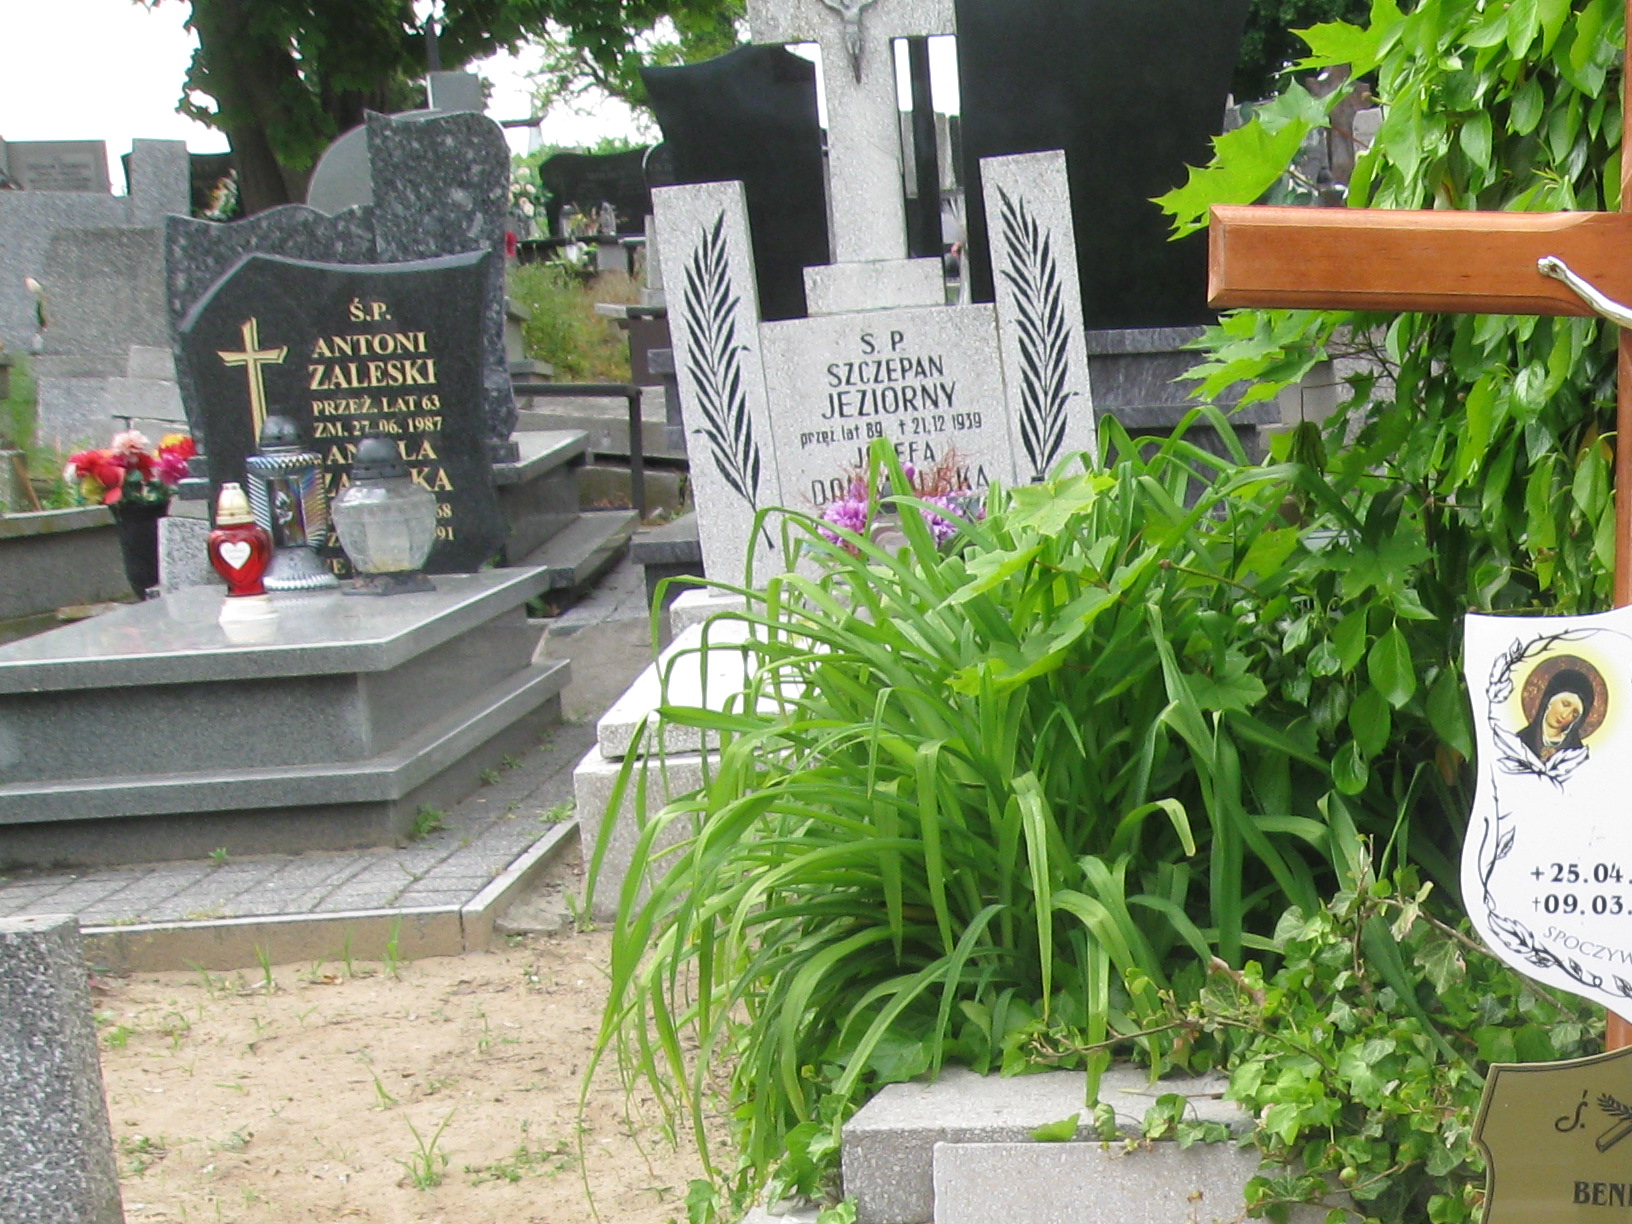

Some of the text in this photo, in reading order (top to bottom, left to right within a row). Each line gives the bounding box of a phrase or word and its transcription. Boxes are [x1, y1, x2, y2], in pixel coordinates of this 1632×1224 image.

[311, 331, 428, 358] ANTONI
[307, 358, 438, 390] ZALESKI
[826, 354, 945, 388] SZCZEPAN
[381, 395, 418, 413] LAT
[421, 394, 441, 411] 63
[821, 381, 957, 420] JEZIORNY
[313, 421, 349, 438] ZM.
[407, 416, 443, 433] 1987
[841, 423, 860, 441] lat
[951, 411, 982, 431] 1939
